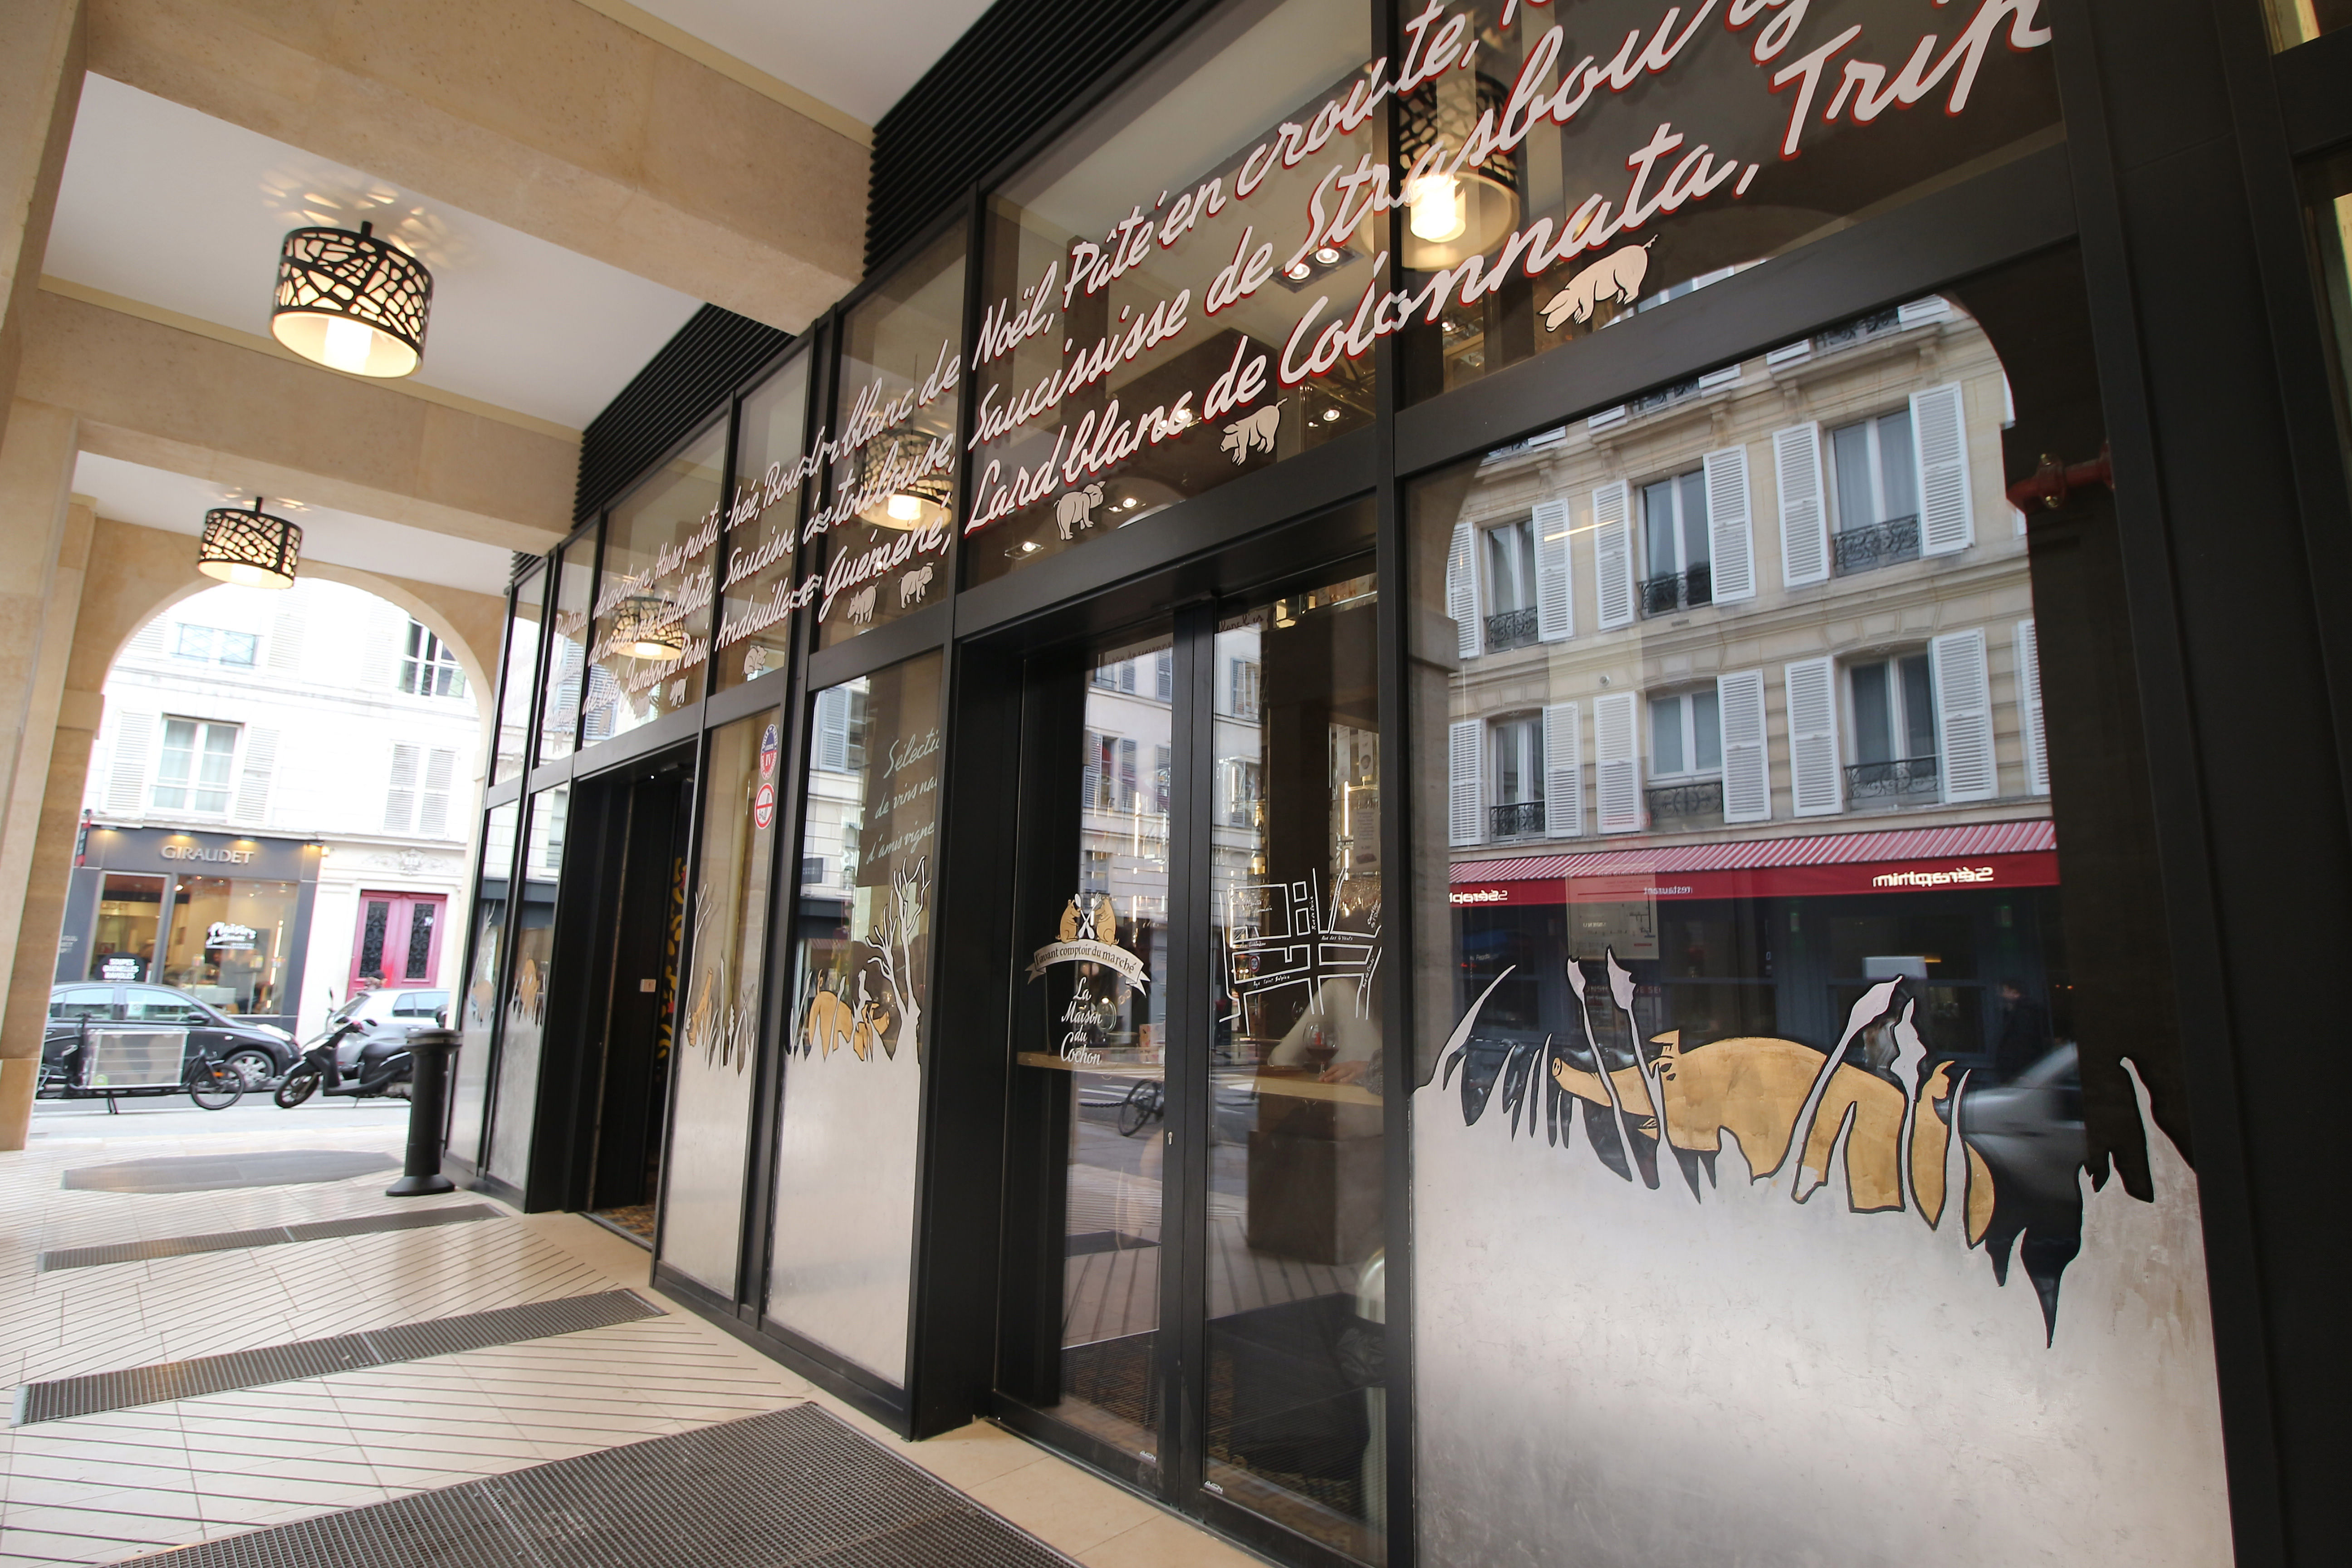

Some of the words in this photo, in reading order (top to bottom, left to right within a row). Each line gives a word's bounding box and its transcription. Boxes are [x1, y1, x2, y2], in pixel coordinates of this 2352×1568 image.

[965, 424, 1068, 534] Lard
[1062, 391, 1195, 487] blanc
[1202, 334, 1267, 423] de
[1278, 122, 1759, 389] Colonnata,
[830, 433, 956, 526] toulouse,
[1205, 225, 1273, 318] de
[593, 583, 606, 620] de
[841, 377, 914, 457] blanc
[918, 339, 960, 407] de
[972, 260, 1058, 372] Noël,
[1157, 177, 1226, 248] en
[875, 793, 889, 819] de
[893, 783, 918, 809] vins
[160, 845, 255, 865] GIRAUDET
[1035, 947, 1058, 966] l'avant
[1060, 943, 1092, 959] comptoir
[1092, 946, 1101, 957] du
[1102, 951, 1137, 975] marché
[1072, 976, 1093, 1001] La
[1061, 1000, 1103, 1025] Maison
[1060, 1031, 1102, 1066] Cochon
[1074, 1024, 1088, 1042] du
